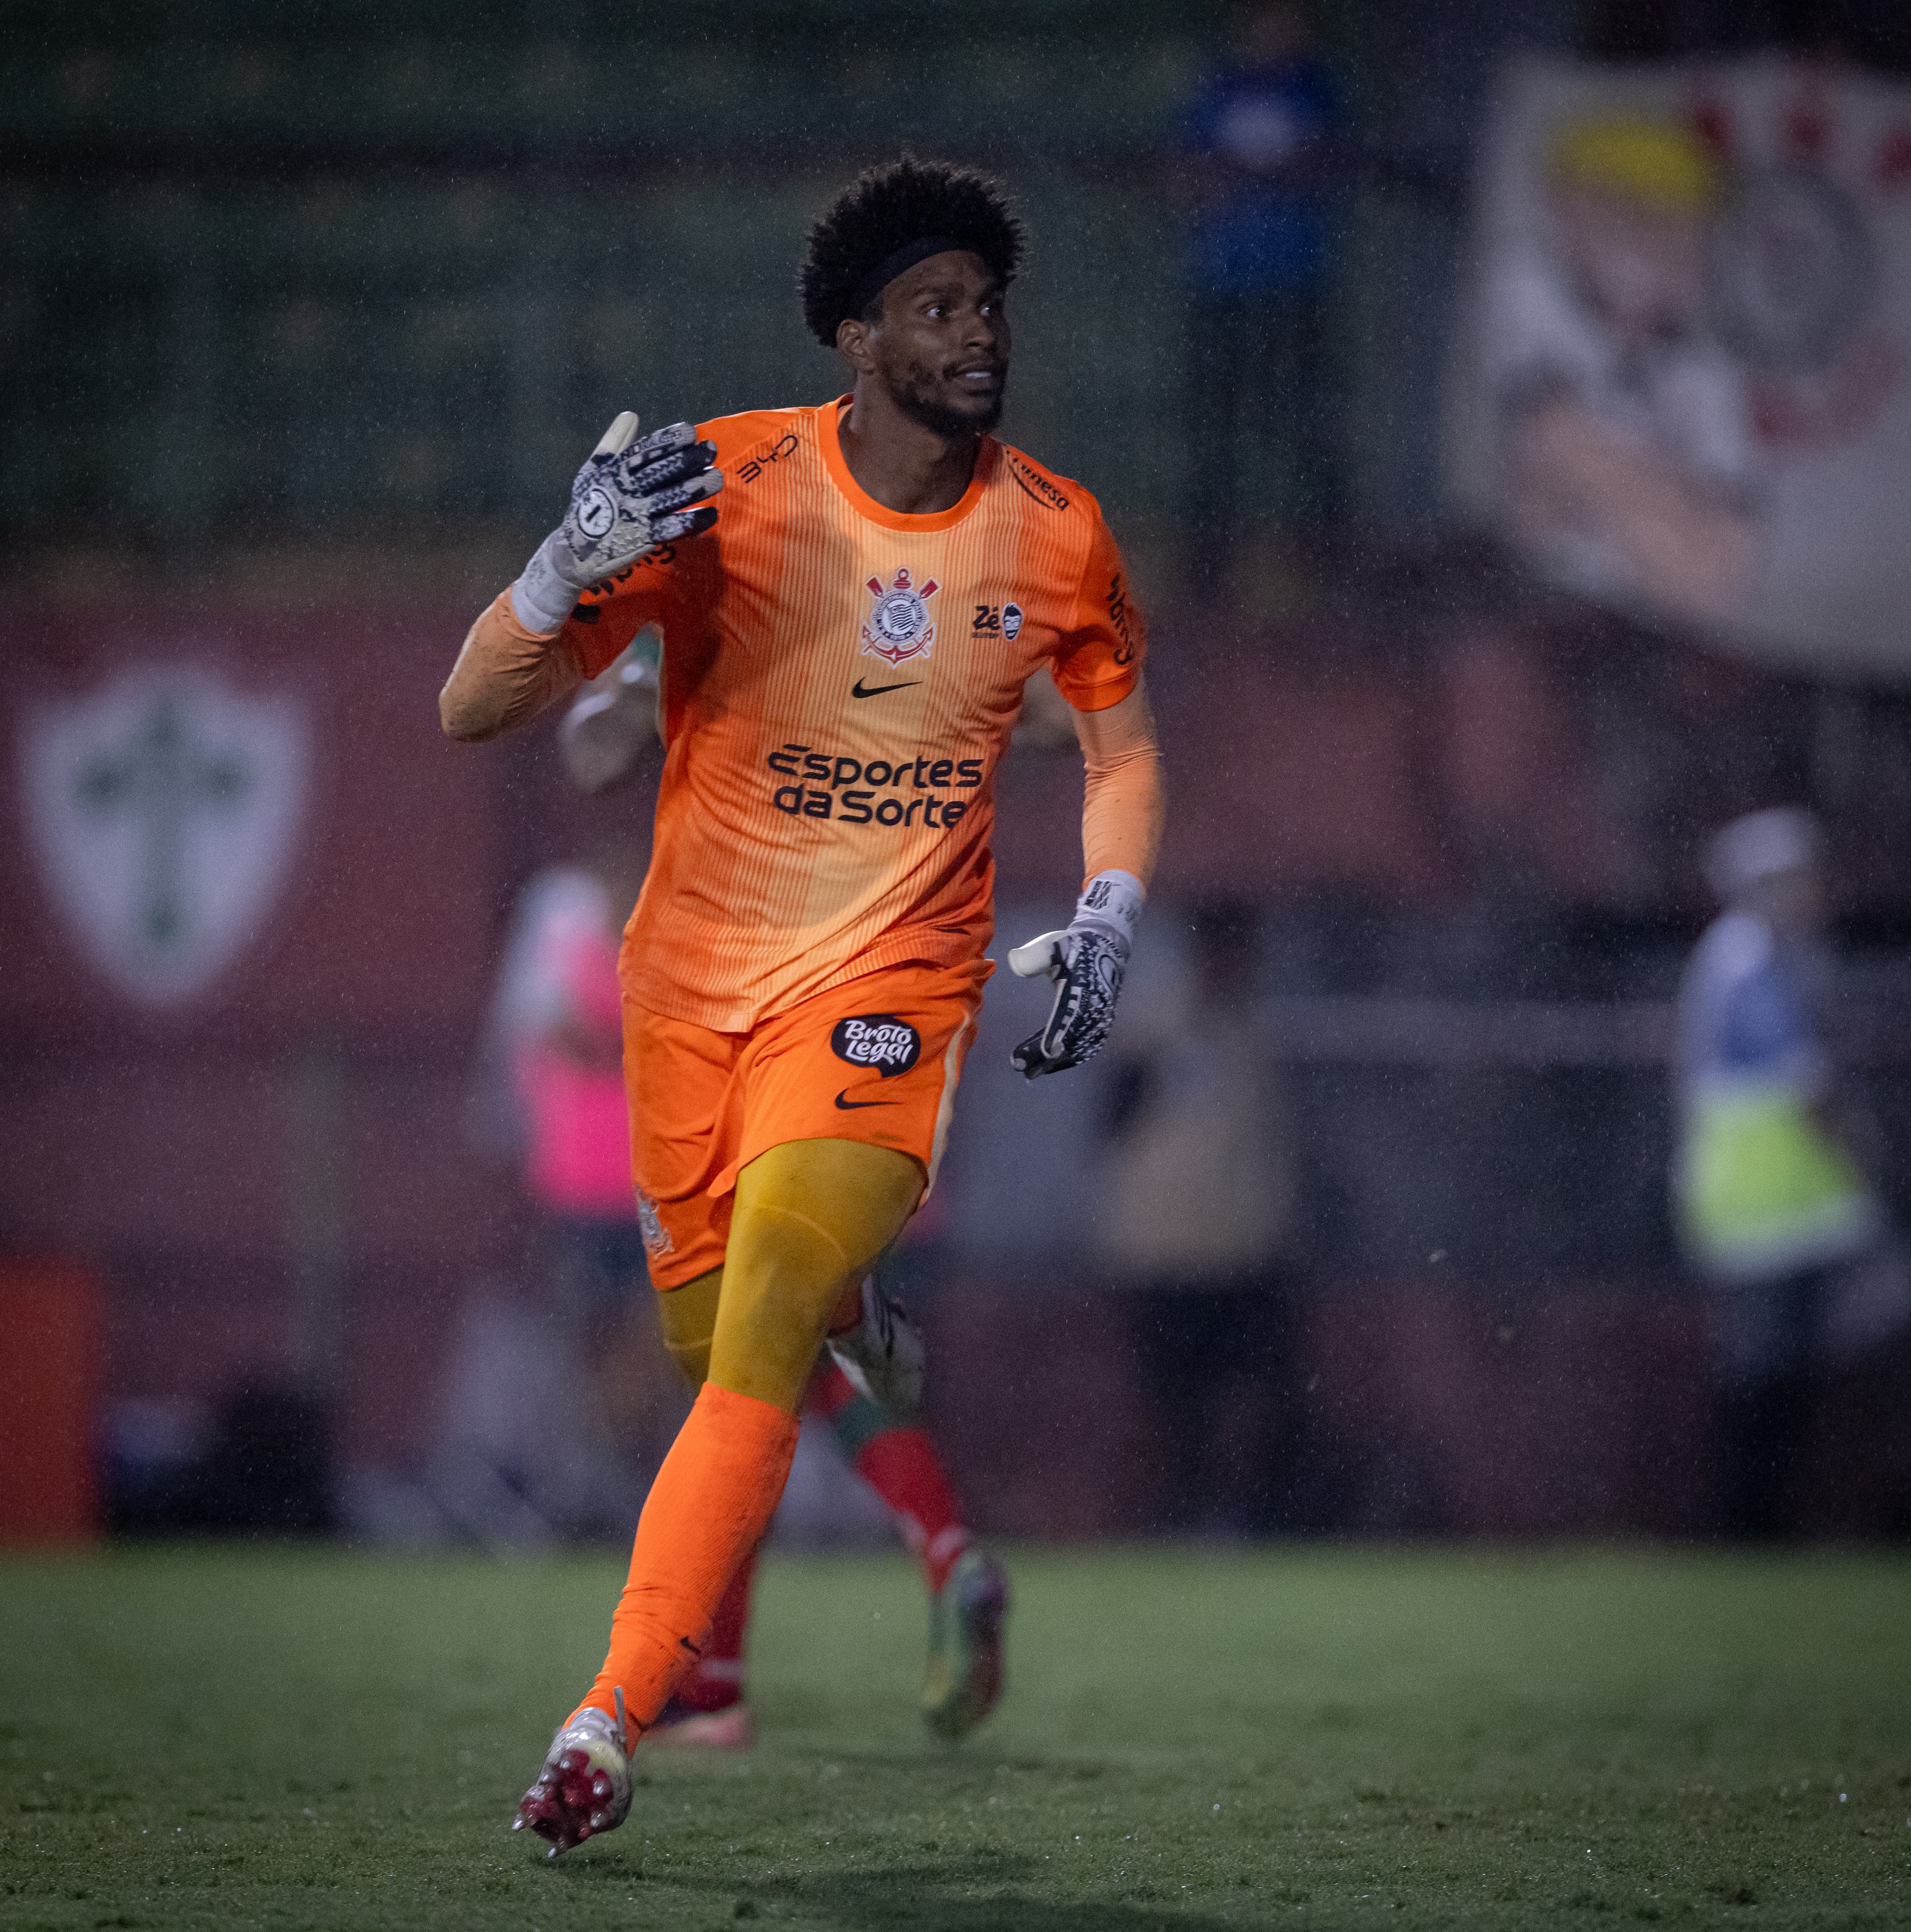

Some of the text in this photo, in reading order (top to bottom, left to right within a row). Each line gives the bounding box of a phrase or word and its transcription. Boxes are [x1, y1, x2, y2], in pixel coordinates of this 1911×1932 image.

[972, 605, 1001, 630] Zé
[768, 743, 985, 790] Esportes
[838, 790, 967, 829] Sorte
[845, 1019, 912, 1045] Broto
[845, 1039, 914, 1065] Legal
